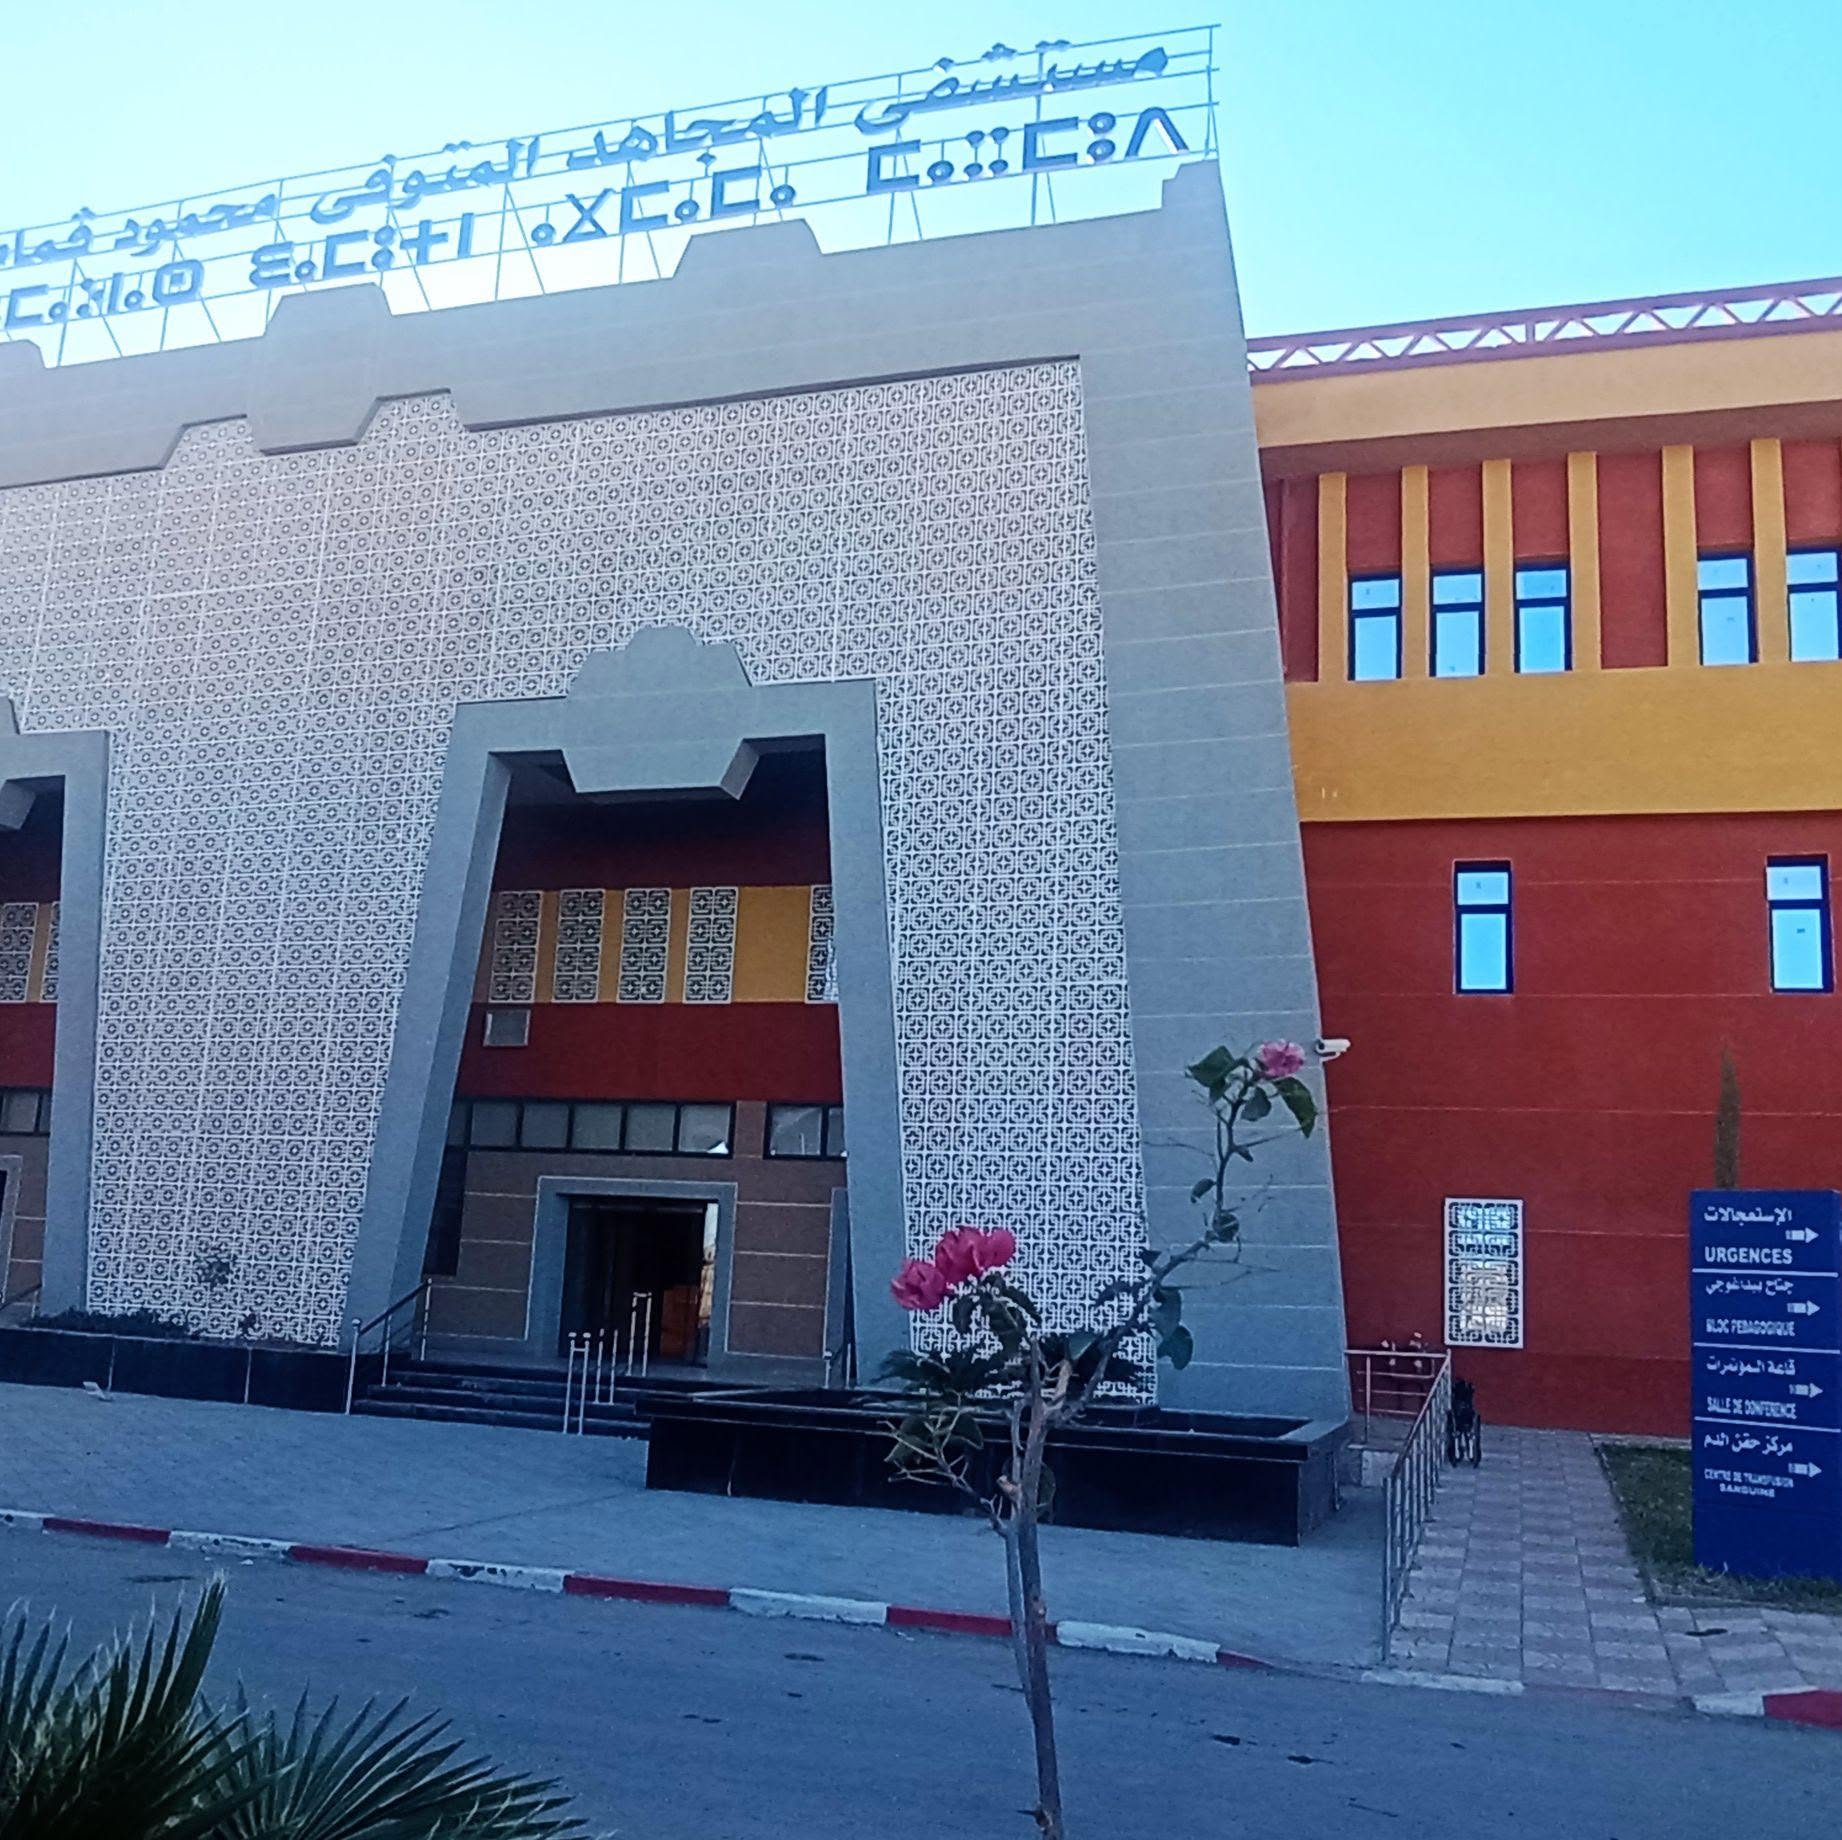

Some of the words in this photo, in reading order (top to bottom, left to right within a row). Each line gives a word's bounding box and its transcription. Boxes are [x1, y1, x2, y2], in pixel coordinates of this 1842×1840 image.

[854, 39, 1169, 135] مستشفى
[566, 86, 828, 168] المجاهد
[310, 136, 541, 225] المتوفى
[114, 194, 279, 257] محمود
[0, 206, 97, 267] قما
[1704, 1206, 1793, 1226] الإستعجالات
[1704, 1246, 1793, 1264] URGENCES
[1765, 1278, 1794, 1296] جناح
[1706, 1318, 1729, 1334] BLOC
[1767, 1358, 1796, 1376] قاعة
[1707, 1396, 1731, 1414] SALLE
[1732, 1398, 1743, 1415] DE
[1703, 1432, 1730, 1448] الدم
[1731, 1432, 1761, 1453] حقن
[1762, 1434, 1794, 1457] مركز
[1704, 1468, 1732, 1482] CENTRE
[1732, 1471, 1743, 1483] DE
[1719, 1483, 1775, 1498] SANGUINE
